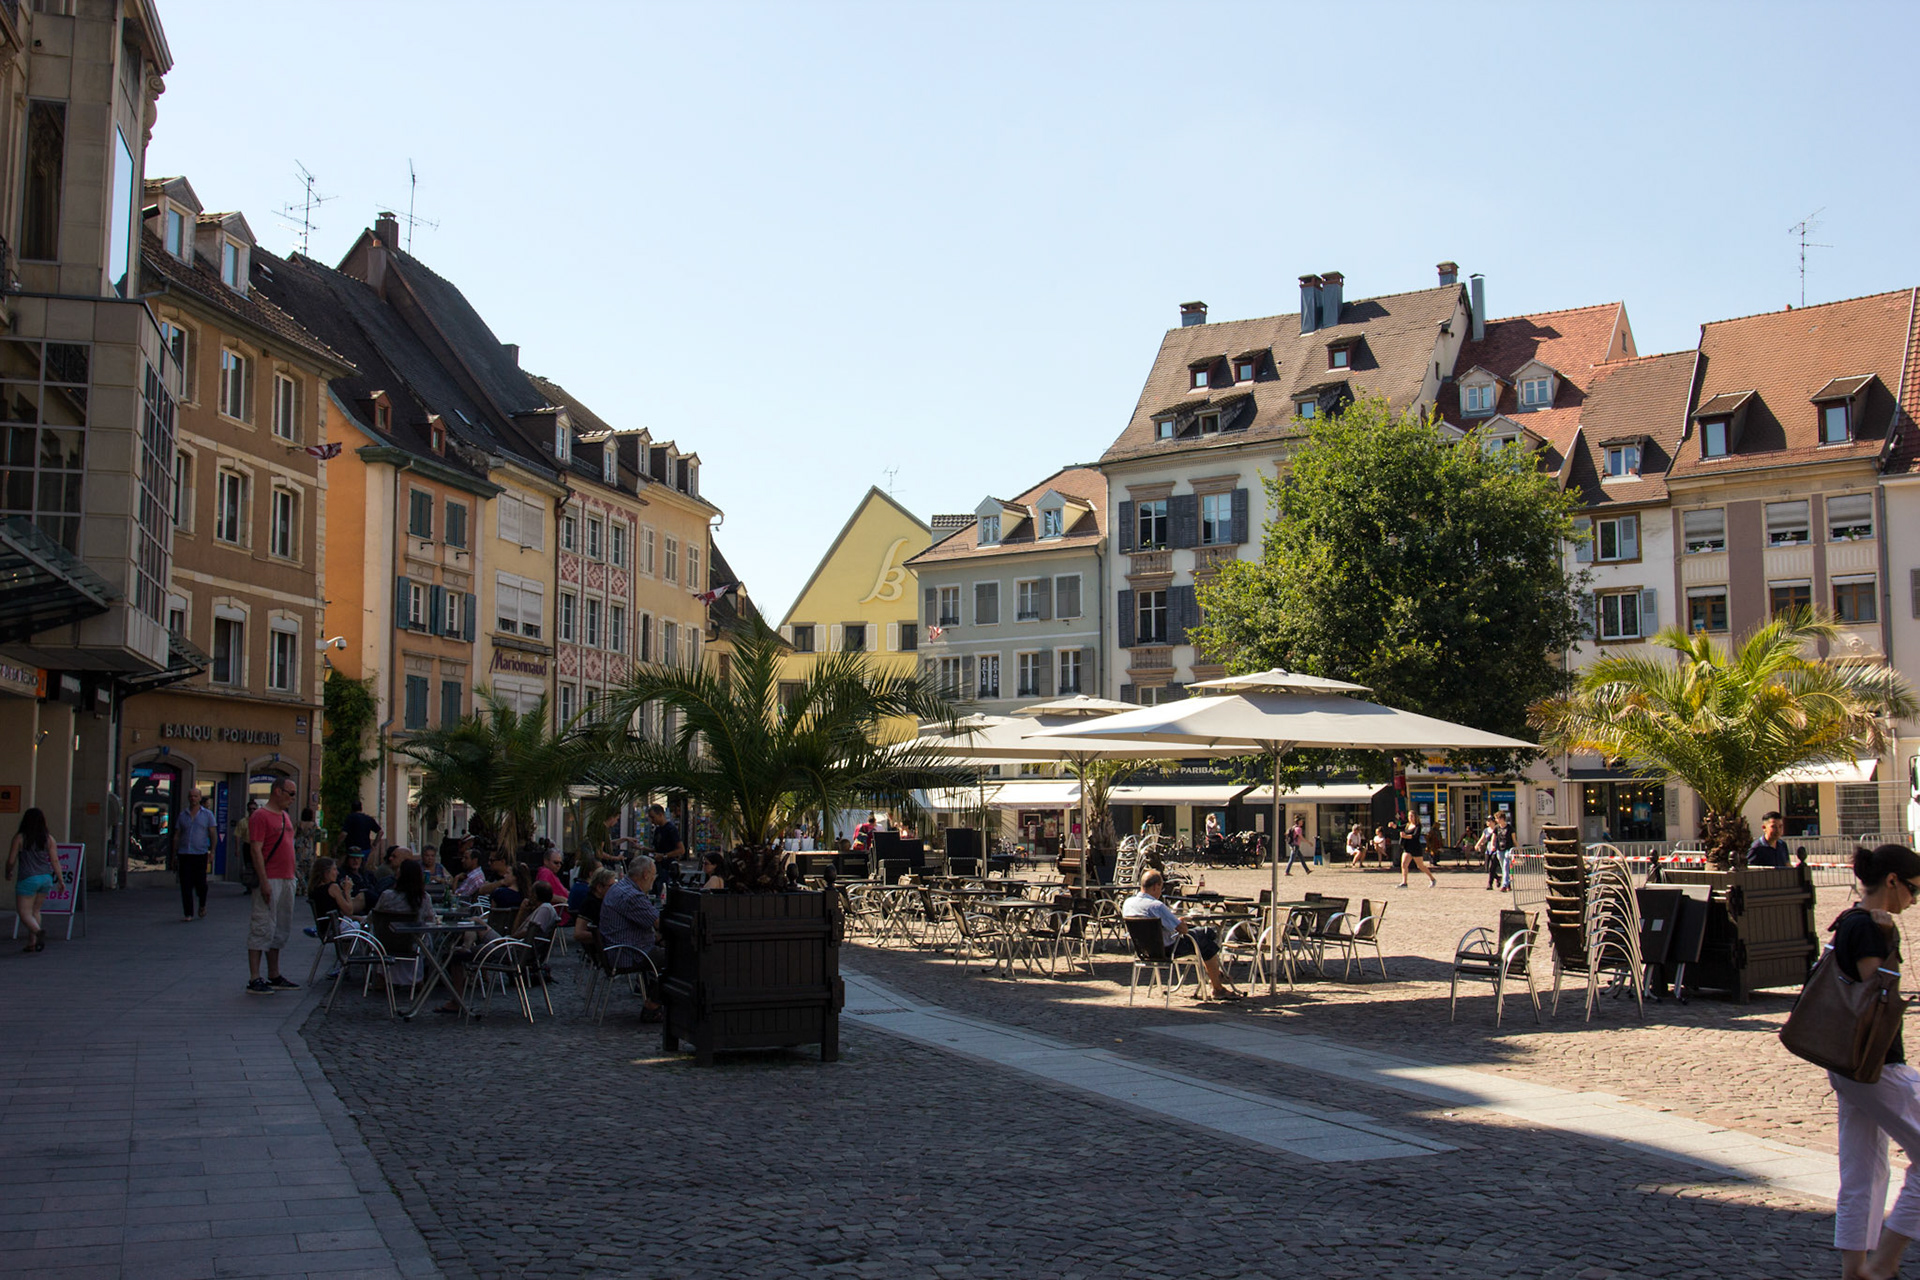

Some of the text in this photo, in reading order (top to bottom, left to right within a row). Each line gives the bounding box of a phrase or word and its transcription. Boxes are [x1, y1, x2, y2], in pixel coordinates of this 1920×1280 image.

[489, 648, 547, 676] Marionnaud
[165, 723, 219, 742] BANQU
[1180, 766, 1220, 774] PARIBAS
